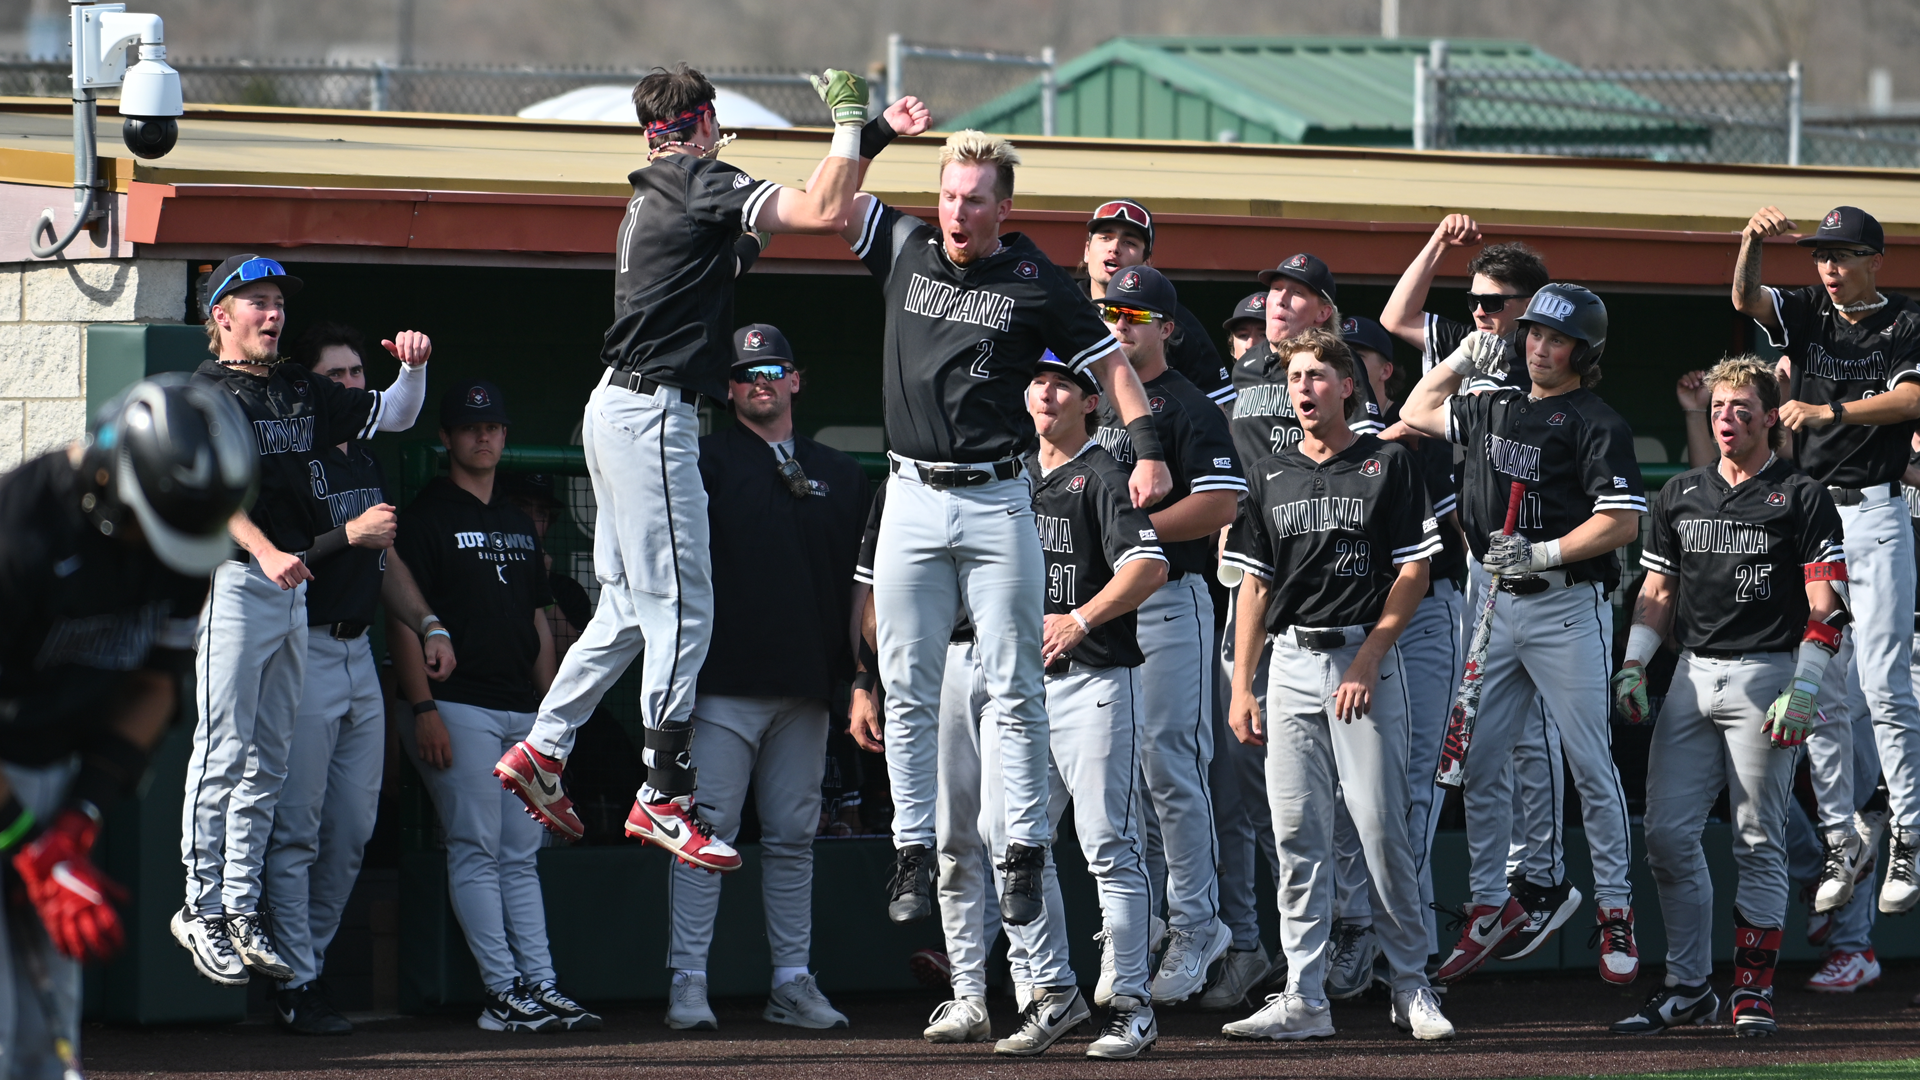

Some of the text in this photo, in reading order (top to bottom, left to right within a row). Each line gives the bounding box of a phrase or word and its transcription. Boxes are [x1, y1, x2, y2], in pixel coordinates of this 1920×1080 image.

[621, 195, 645, 274] 1
[904, 272, 1015, 333] INDIANA
[1533, 292, 1576, 322] IUP
[970, 338, 994, 379] 2
[1272, 497, 1365, 539] INDIANA
[1677, 519, 1769, 554] INDIANA
[1335, 538, 1371, 577] 28
[1048, 562, 1077, 606] 31
[1735, 563, 1773, 603] 25
